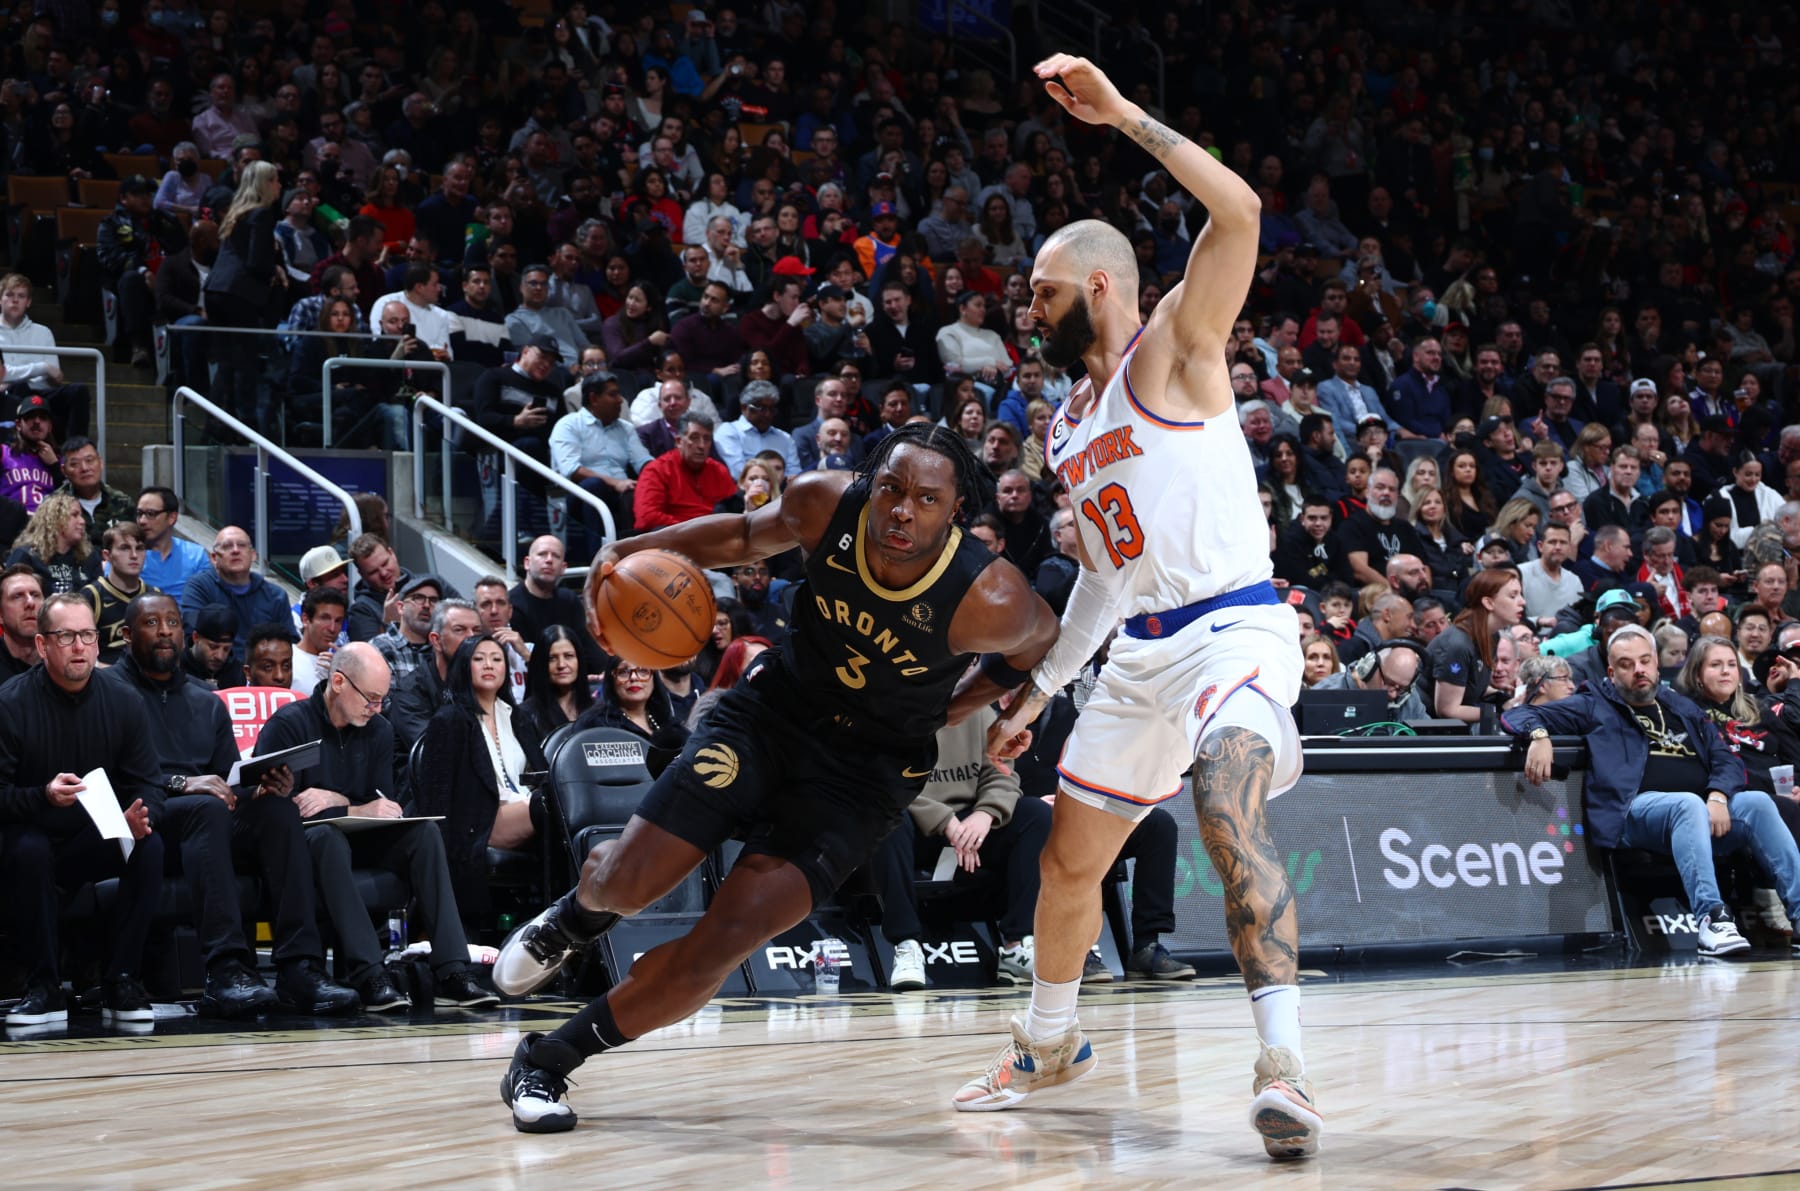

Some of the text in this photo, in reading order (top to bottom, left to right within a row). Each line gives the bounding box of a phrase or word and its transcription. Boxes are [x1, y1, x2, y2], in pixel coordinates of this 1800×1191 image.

[21, 484, 44, 504] 15
[1081, 481, 1145, 571] 13
[838, 533, 853, 551] 6
[835, 643, 871, 690] 3
[587, 749, 640, 759] COACHING
[594, 743, 638, 751] EXECUTIVE
[1379, 828, 1565, 889] Scene
[765, 943, 853, 970] AXE
